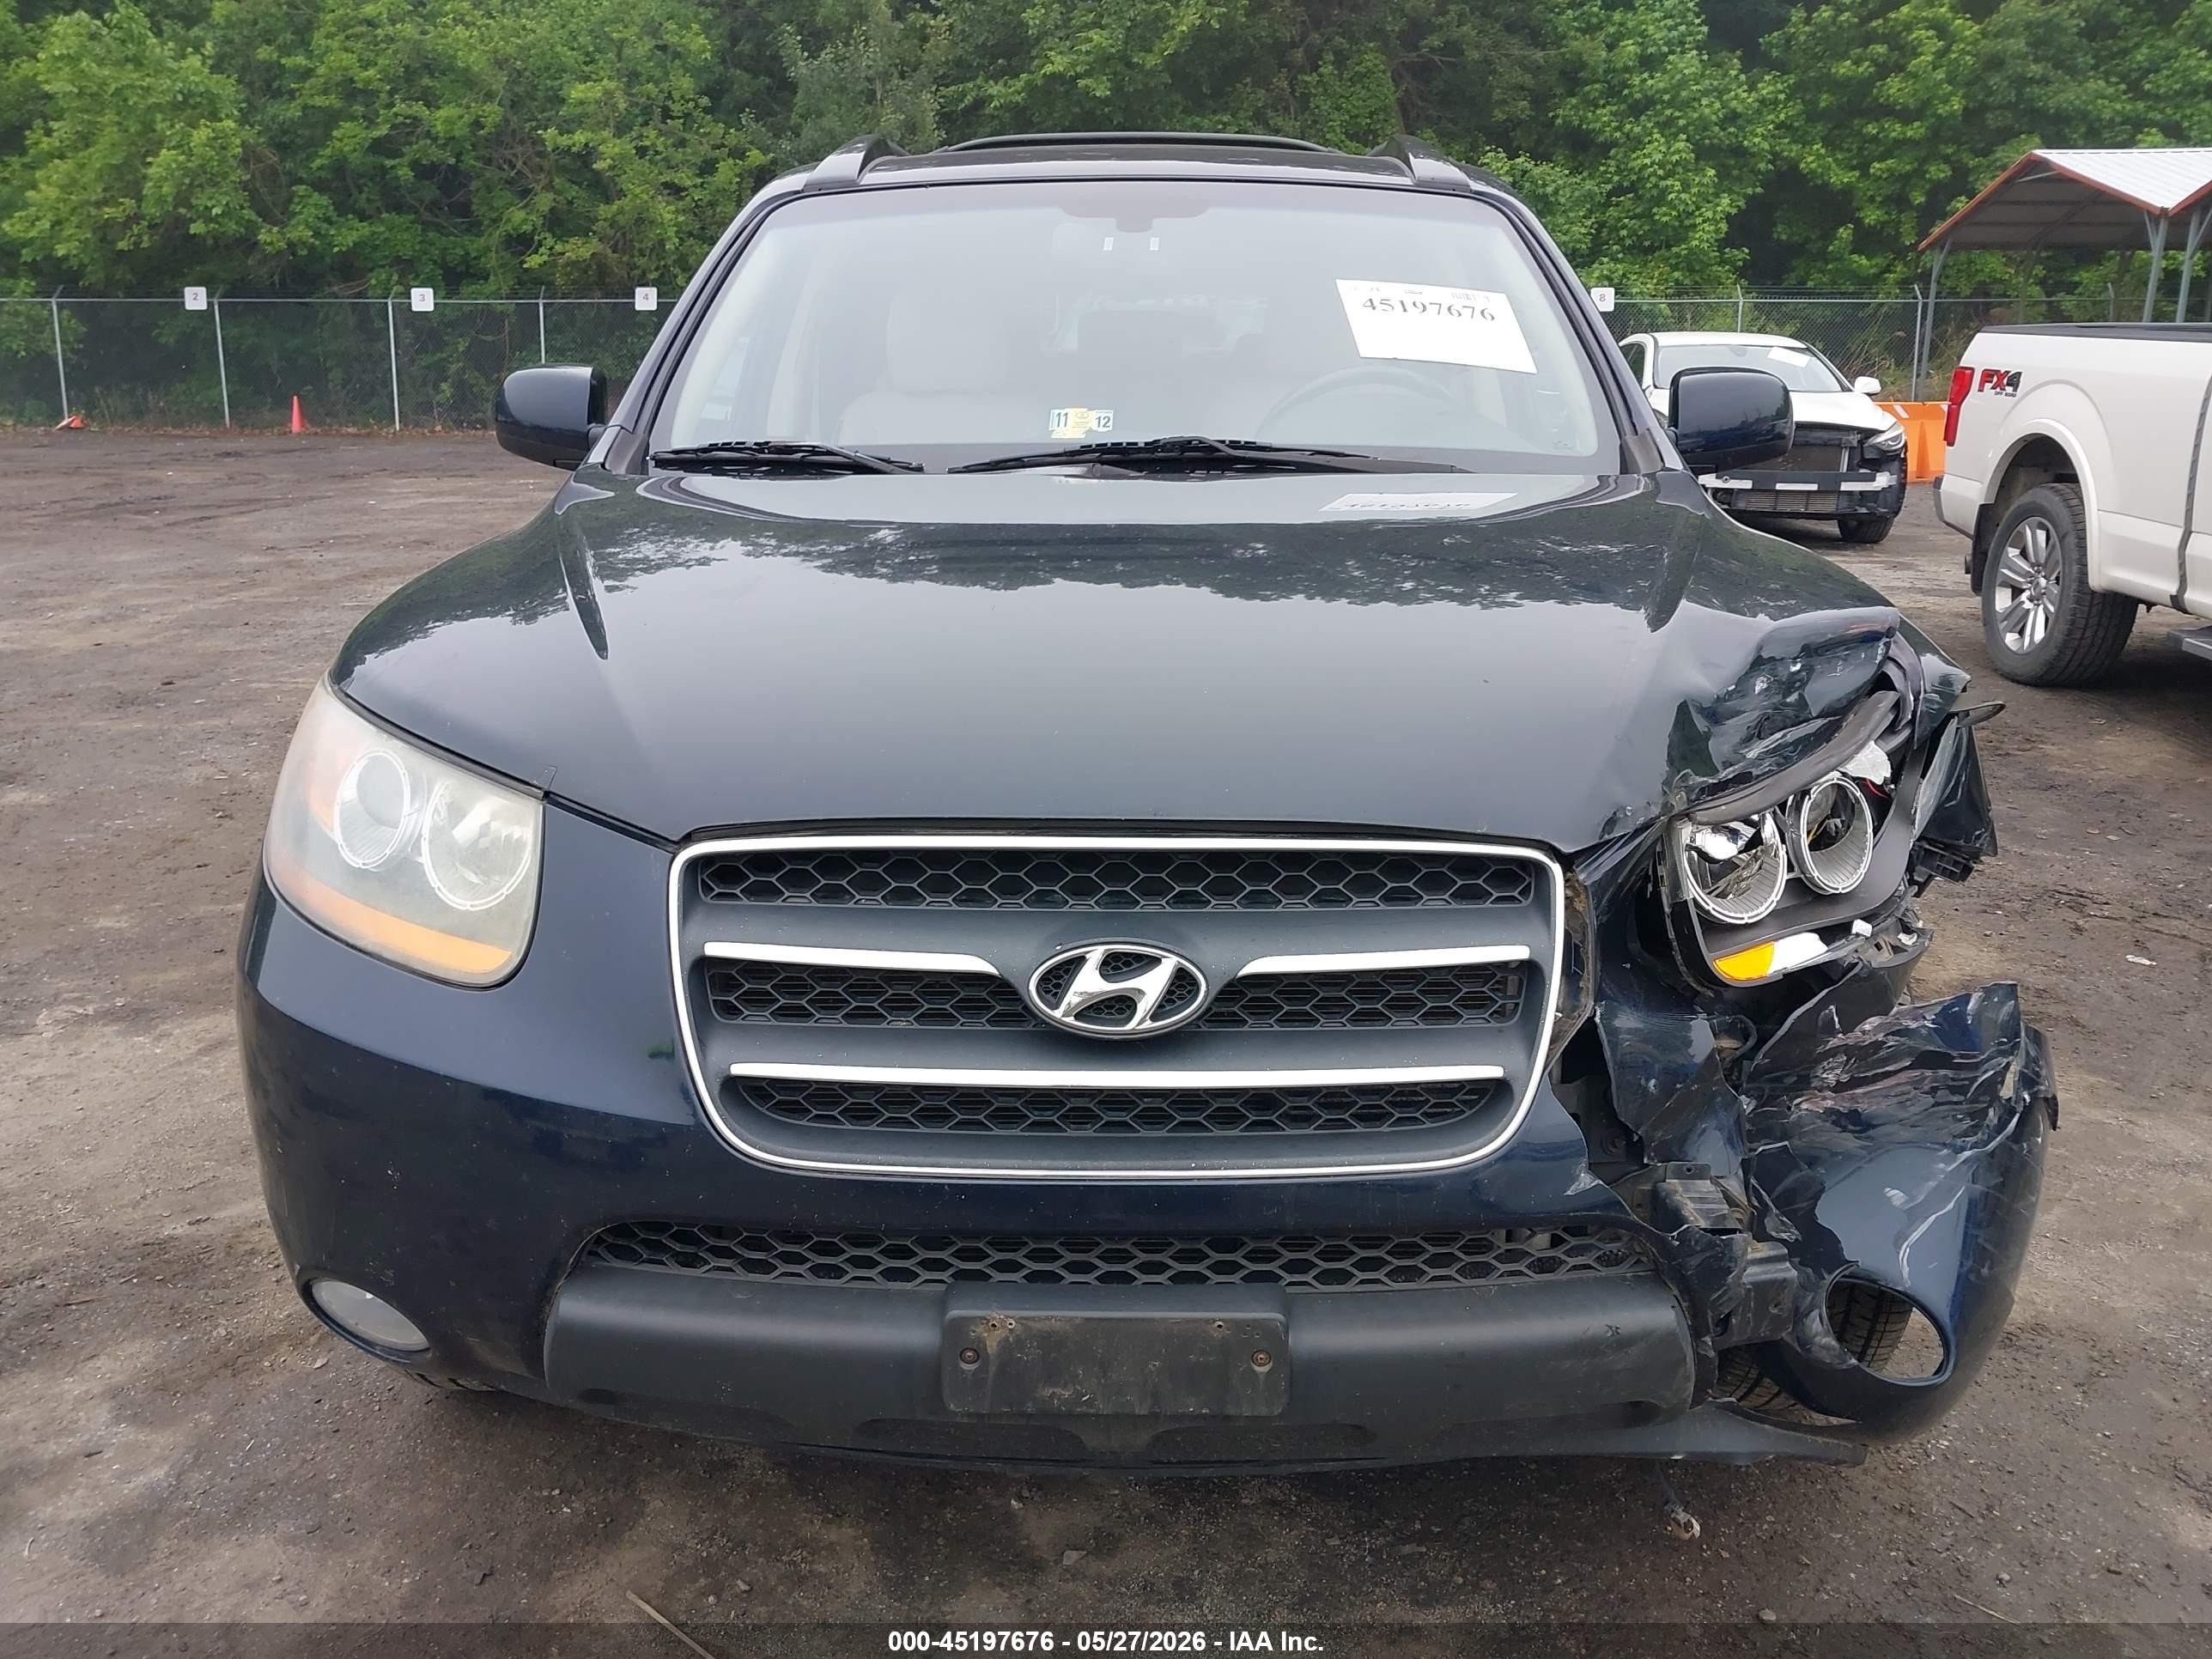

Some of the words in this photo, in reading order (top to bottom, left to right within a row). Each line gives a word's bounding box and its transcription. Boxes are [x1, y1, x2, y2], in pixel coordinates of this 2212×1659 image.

[192, 292, 199, 301] 2
[418, 294, 426, 302] 3
[1362, 297, 1496, 322] 45197676
[1977, 368, 2023, 393] FX4
[1056, 411, 1069, 428] 11
[1096, 416, 1111, 428] 12
